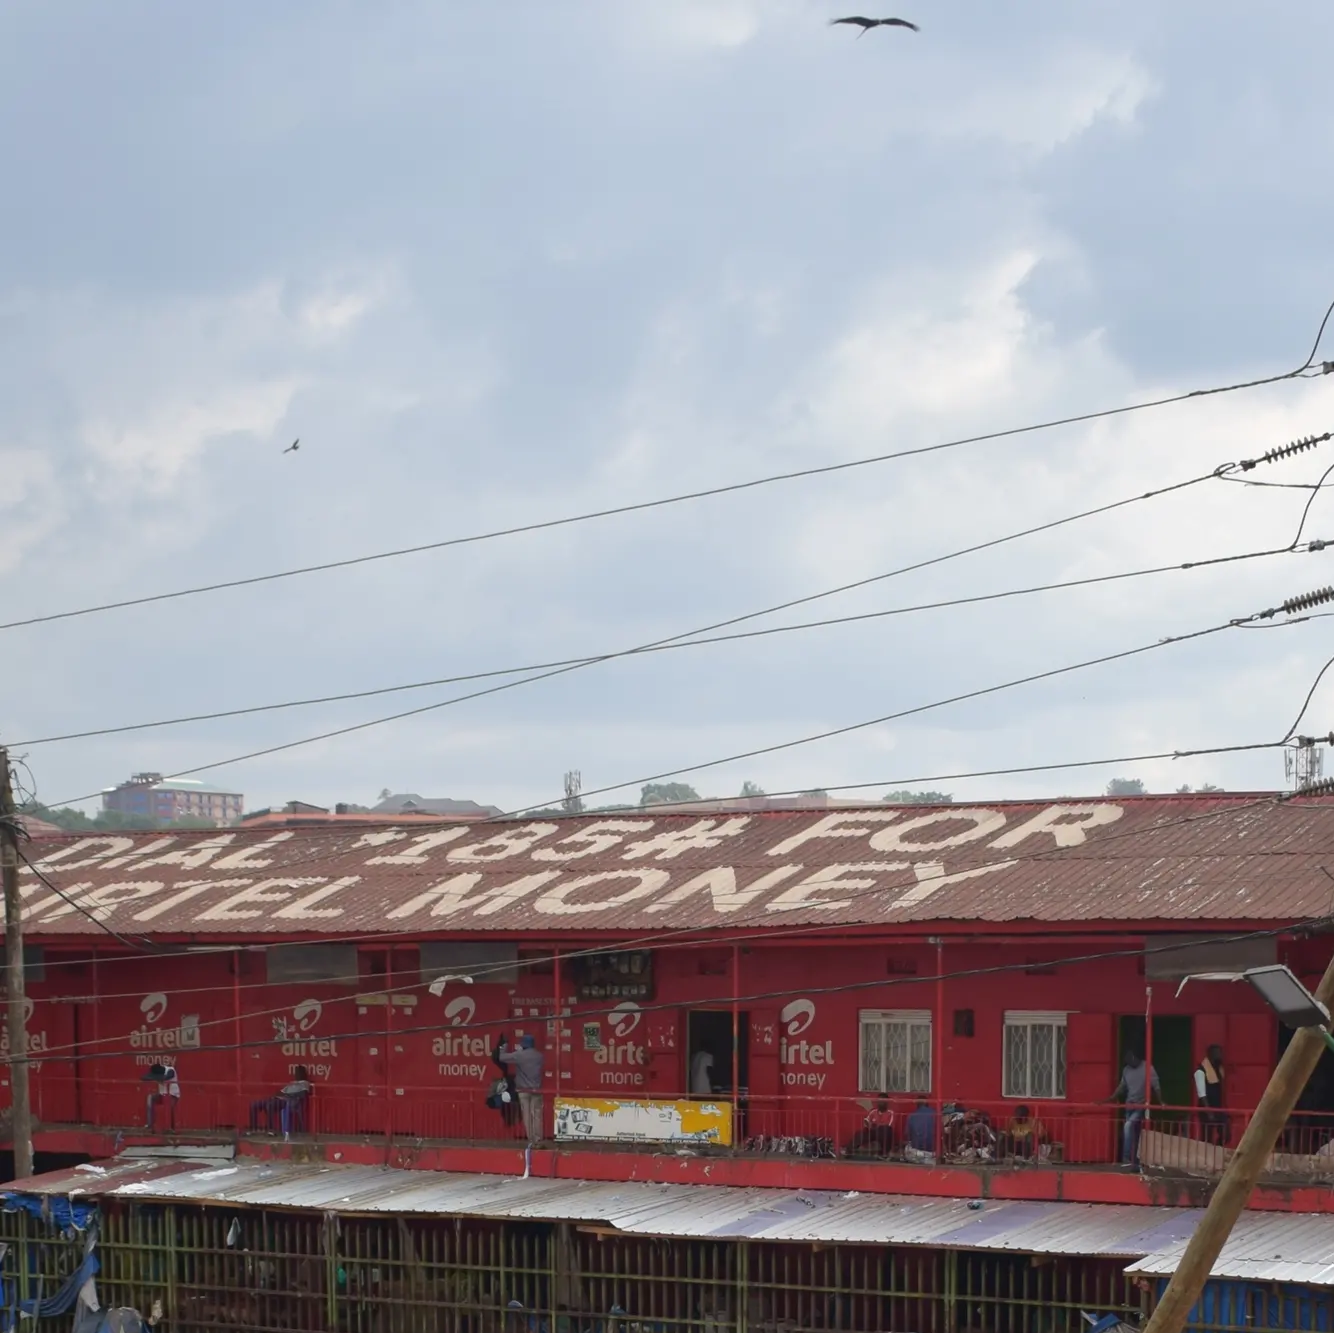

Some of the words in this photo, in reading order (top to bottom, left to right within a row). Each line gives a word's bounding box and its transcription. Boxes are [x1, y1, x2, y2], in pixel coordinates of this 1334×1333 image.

[765, 803, 1124, 856] FOR
[386, 858, 1018, 919] MONEY
[130, 1025, 182, 1048] airtel
[281, 1033, 338, 1057] airtel
[432, 1032, 492, 1057] airtel
[136, 1054, 177, 1067] money
[439, 1063, 487, 1080] money
